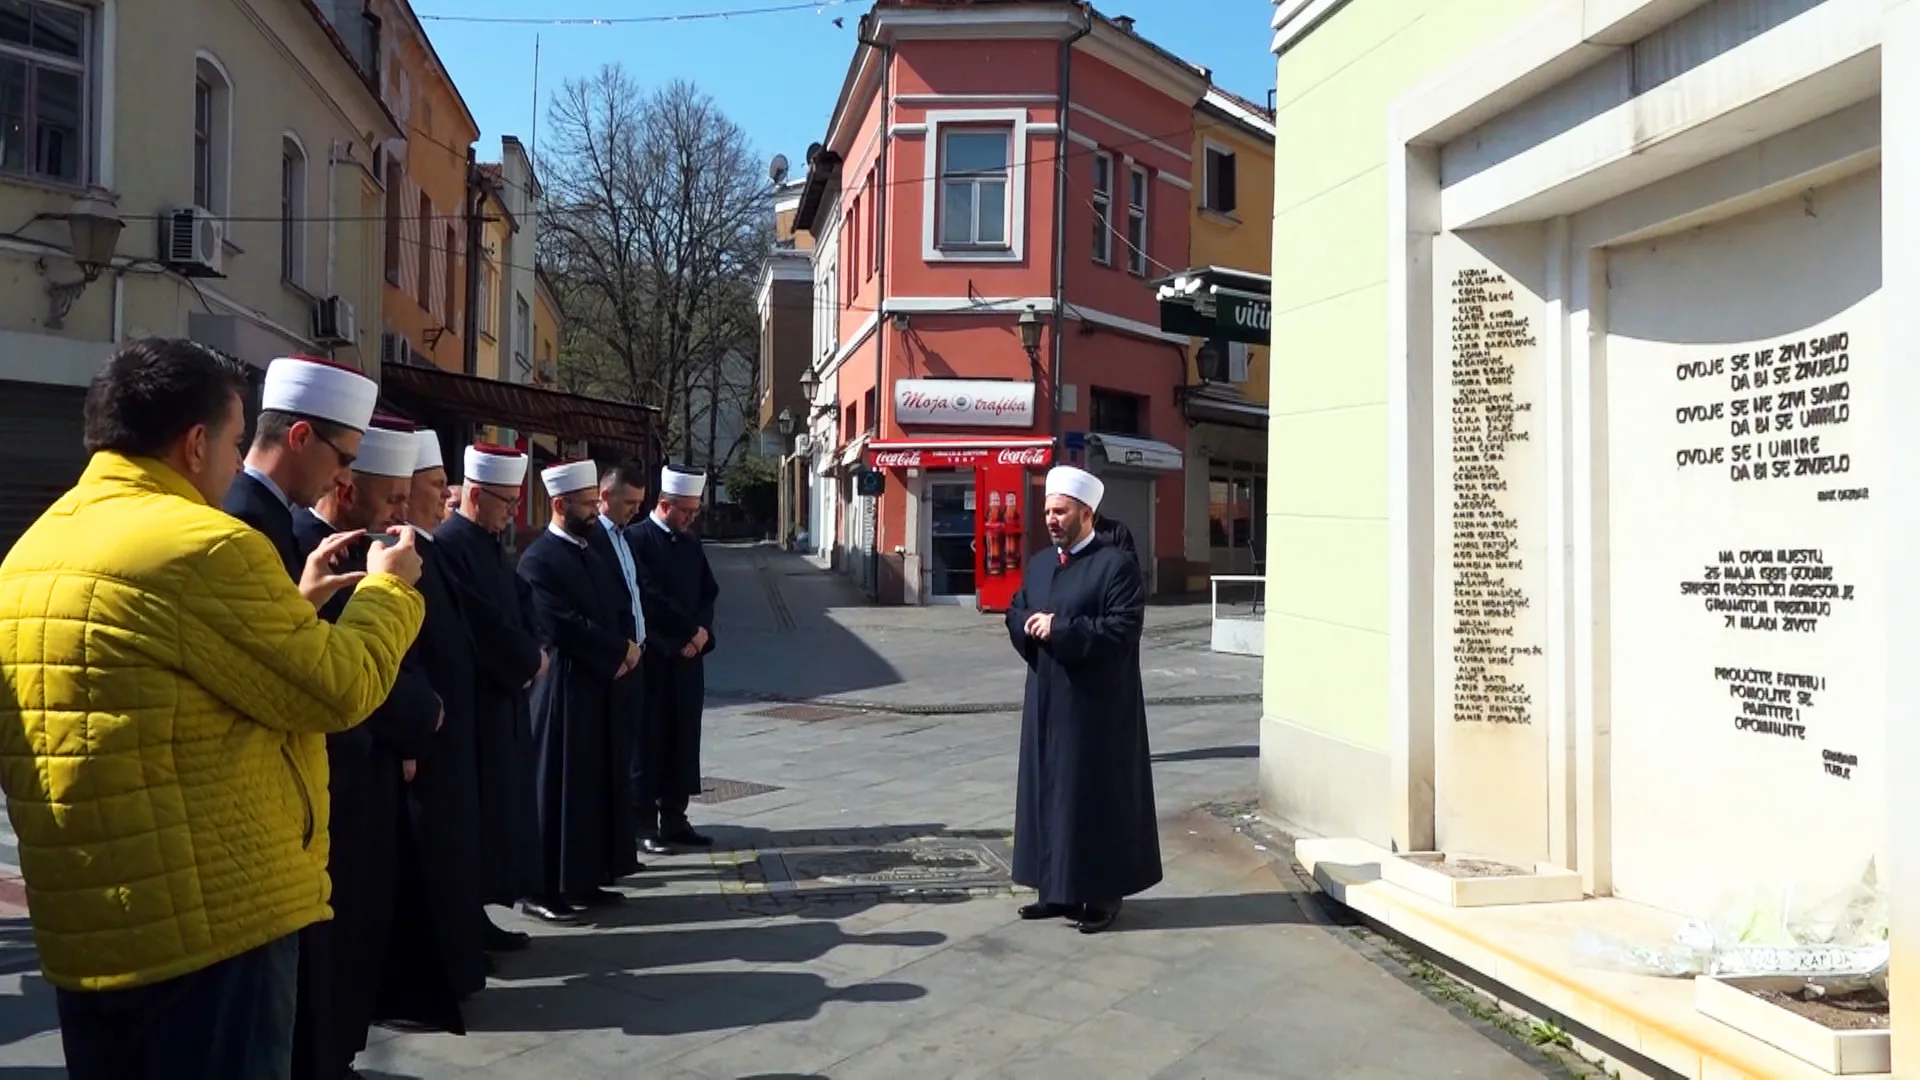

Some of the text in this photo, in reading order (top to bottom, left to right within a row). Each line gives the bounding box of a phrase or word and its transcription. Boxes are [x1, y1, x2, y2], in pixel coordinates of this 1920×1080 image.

[1676, 358, 1724, 380] OVDJE
[1731, 353, 1750, 371] SE
[1755, 349, 1774, 368] NE
[1809, 332, 1849, 357] SAMO
[1731, 374, 1750, 391] DA
[1754, 370, 1768, 388] BI
[1773, 366, 1791, 384] SE
[902, 391, 1027, 416] Moja trafika
[1676, 403, 1724, 424] OVDJE
[1730, 399, 1749, 417] SE
[1753, 395, 1773, 413] NE
[1731, 419, 1750, 437] DA
[1755, 416, 1769, 434] BI
[1775, 413, 1793, 431] SE
[1677, 447, 1724, 466] OVDJE
[1731, 444, 1751, 462] SE
[1768, 436, 1820, 458] UMIRE
[1730, 464, 1750, 482] DA
[1754, 462, 1767, 480] BI
[1772, 460, 1790, 478] SE
